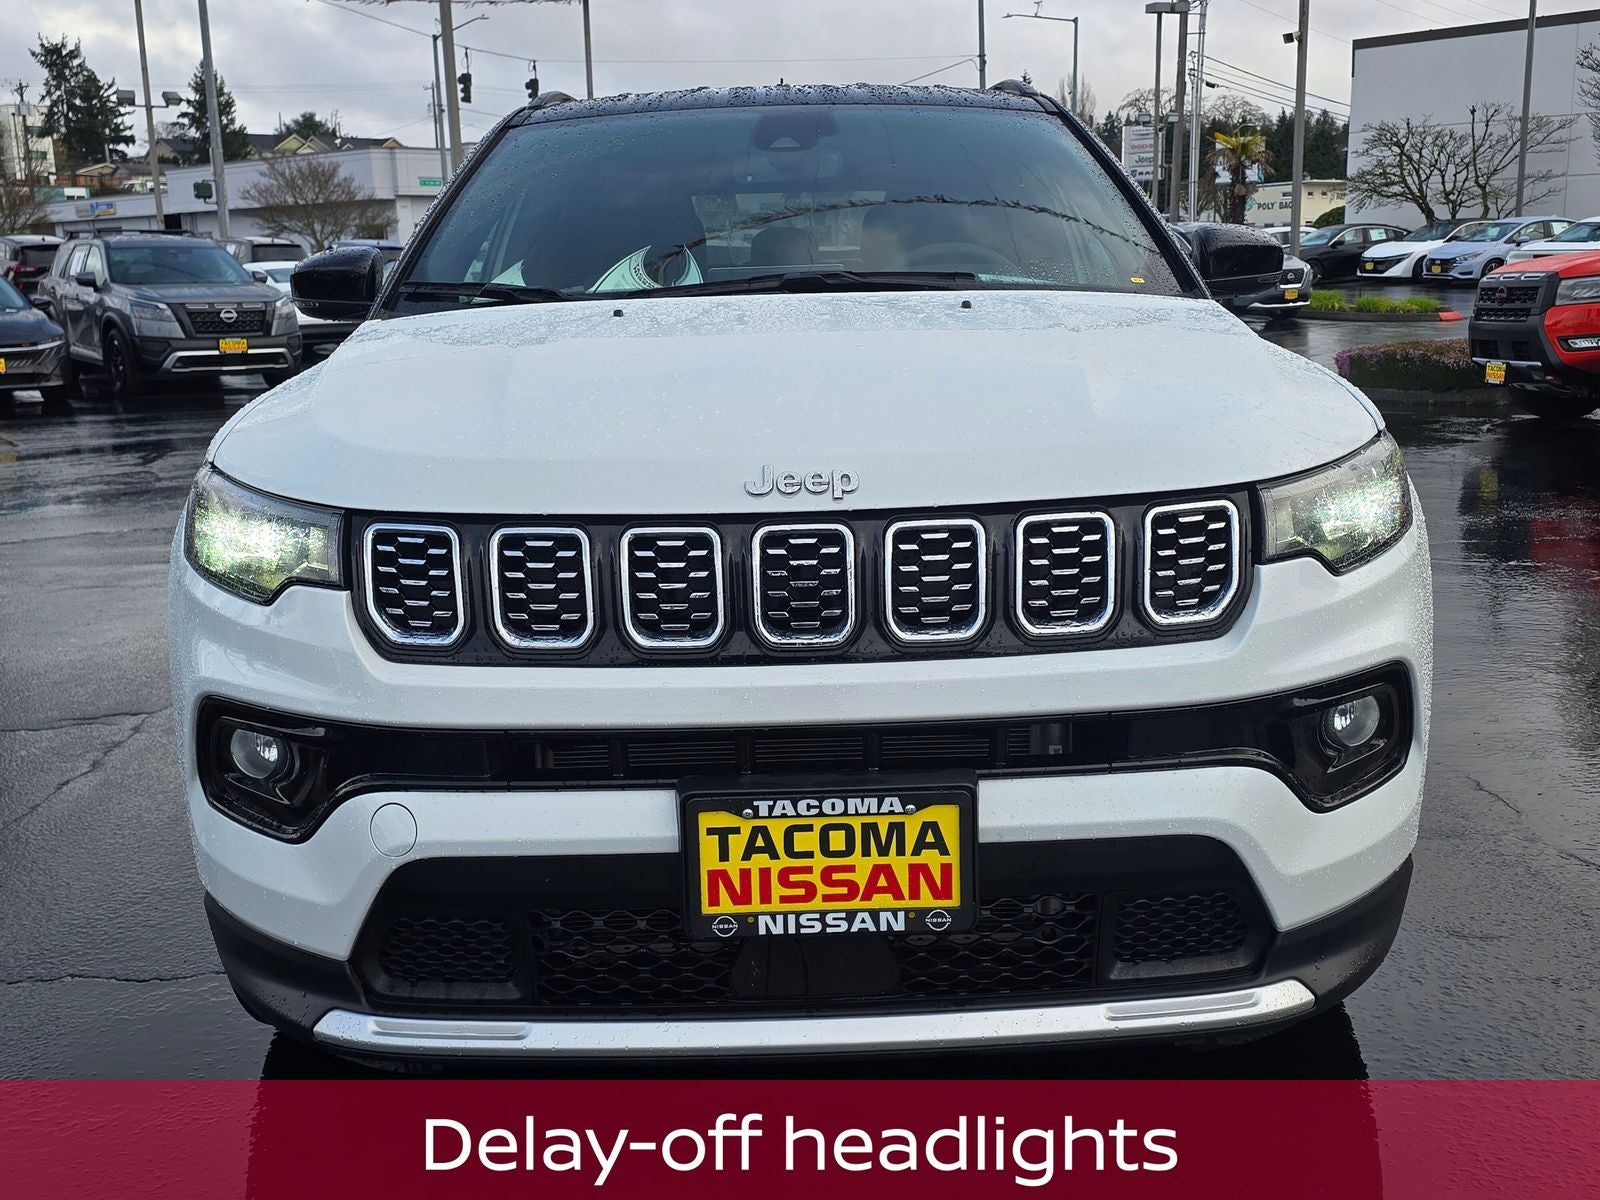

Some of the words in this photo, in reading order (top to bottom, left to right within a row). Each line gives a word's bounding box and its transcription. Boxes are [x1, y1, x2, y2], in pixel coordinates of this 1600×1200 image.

[1257, 202, 1277, 210] POLY
[744, 464, 859, 500] Jeep
[753, 797, 904, 816] TACOMA
[706, 821, 951, 862] TACOMA
[707, 863, 953, 907] NISSAN
[758, 911, 905, 935] NISSAN
